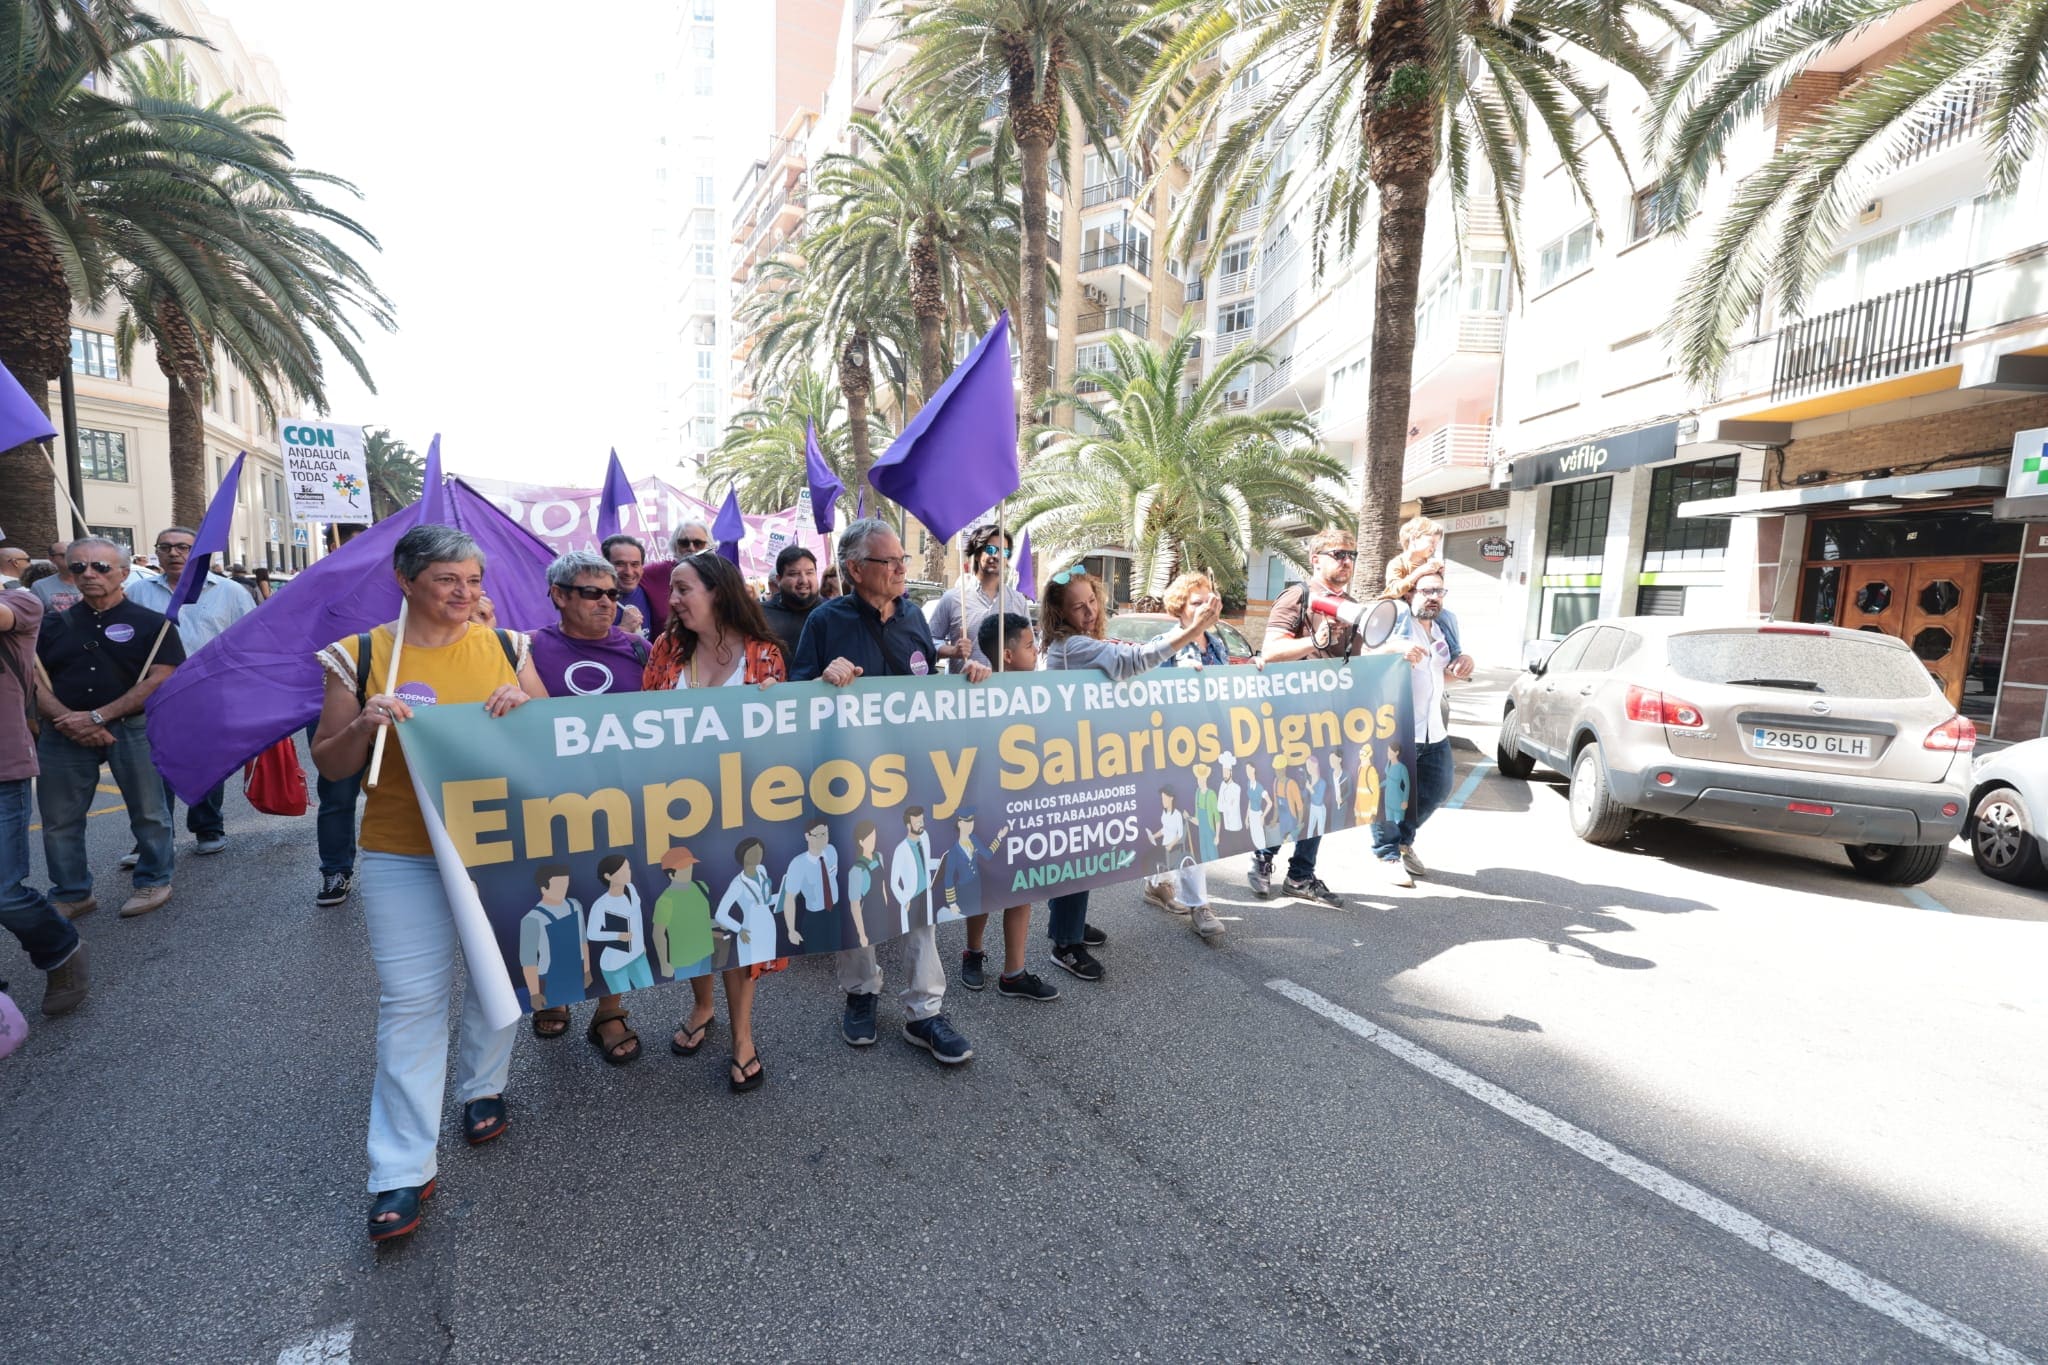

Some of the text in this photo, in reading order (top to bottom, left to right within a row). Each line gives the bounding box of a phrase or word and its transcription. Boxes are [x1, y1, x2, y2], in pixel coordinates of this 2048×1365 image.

[284, 425, 335, 447] CON
[288, 447, 351, 460] ANDALUCÍA
[289, 458, 337, 472] MÁLAGA
[290, 471, 328, 483] TODAS
[769, 532, 785, 542] CON
[393, 692, 437, 704] PODEMOS
[553, 667, 1354, 757] BASTA DE PRECARIEDAD Y RECORTES DE DERECHOS
[1766, 731, 1864, 755] 2950 GLH
[441, 702, 1396, 867] Empleos y Salarios Dignos
[1006, 784, 1136, 814] CON LOS TRABAJADORES
[1007, 799, 1137, 831] Y LAS TRABAJADORAS
[1007, 816, 1139, 865] PODEMOS
[1011, 845, 1136, 893] ANDALUCÍA
